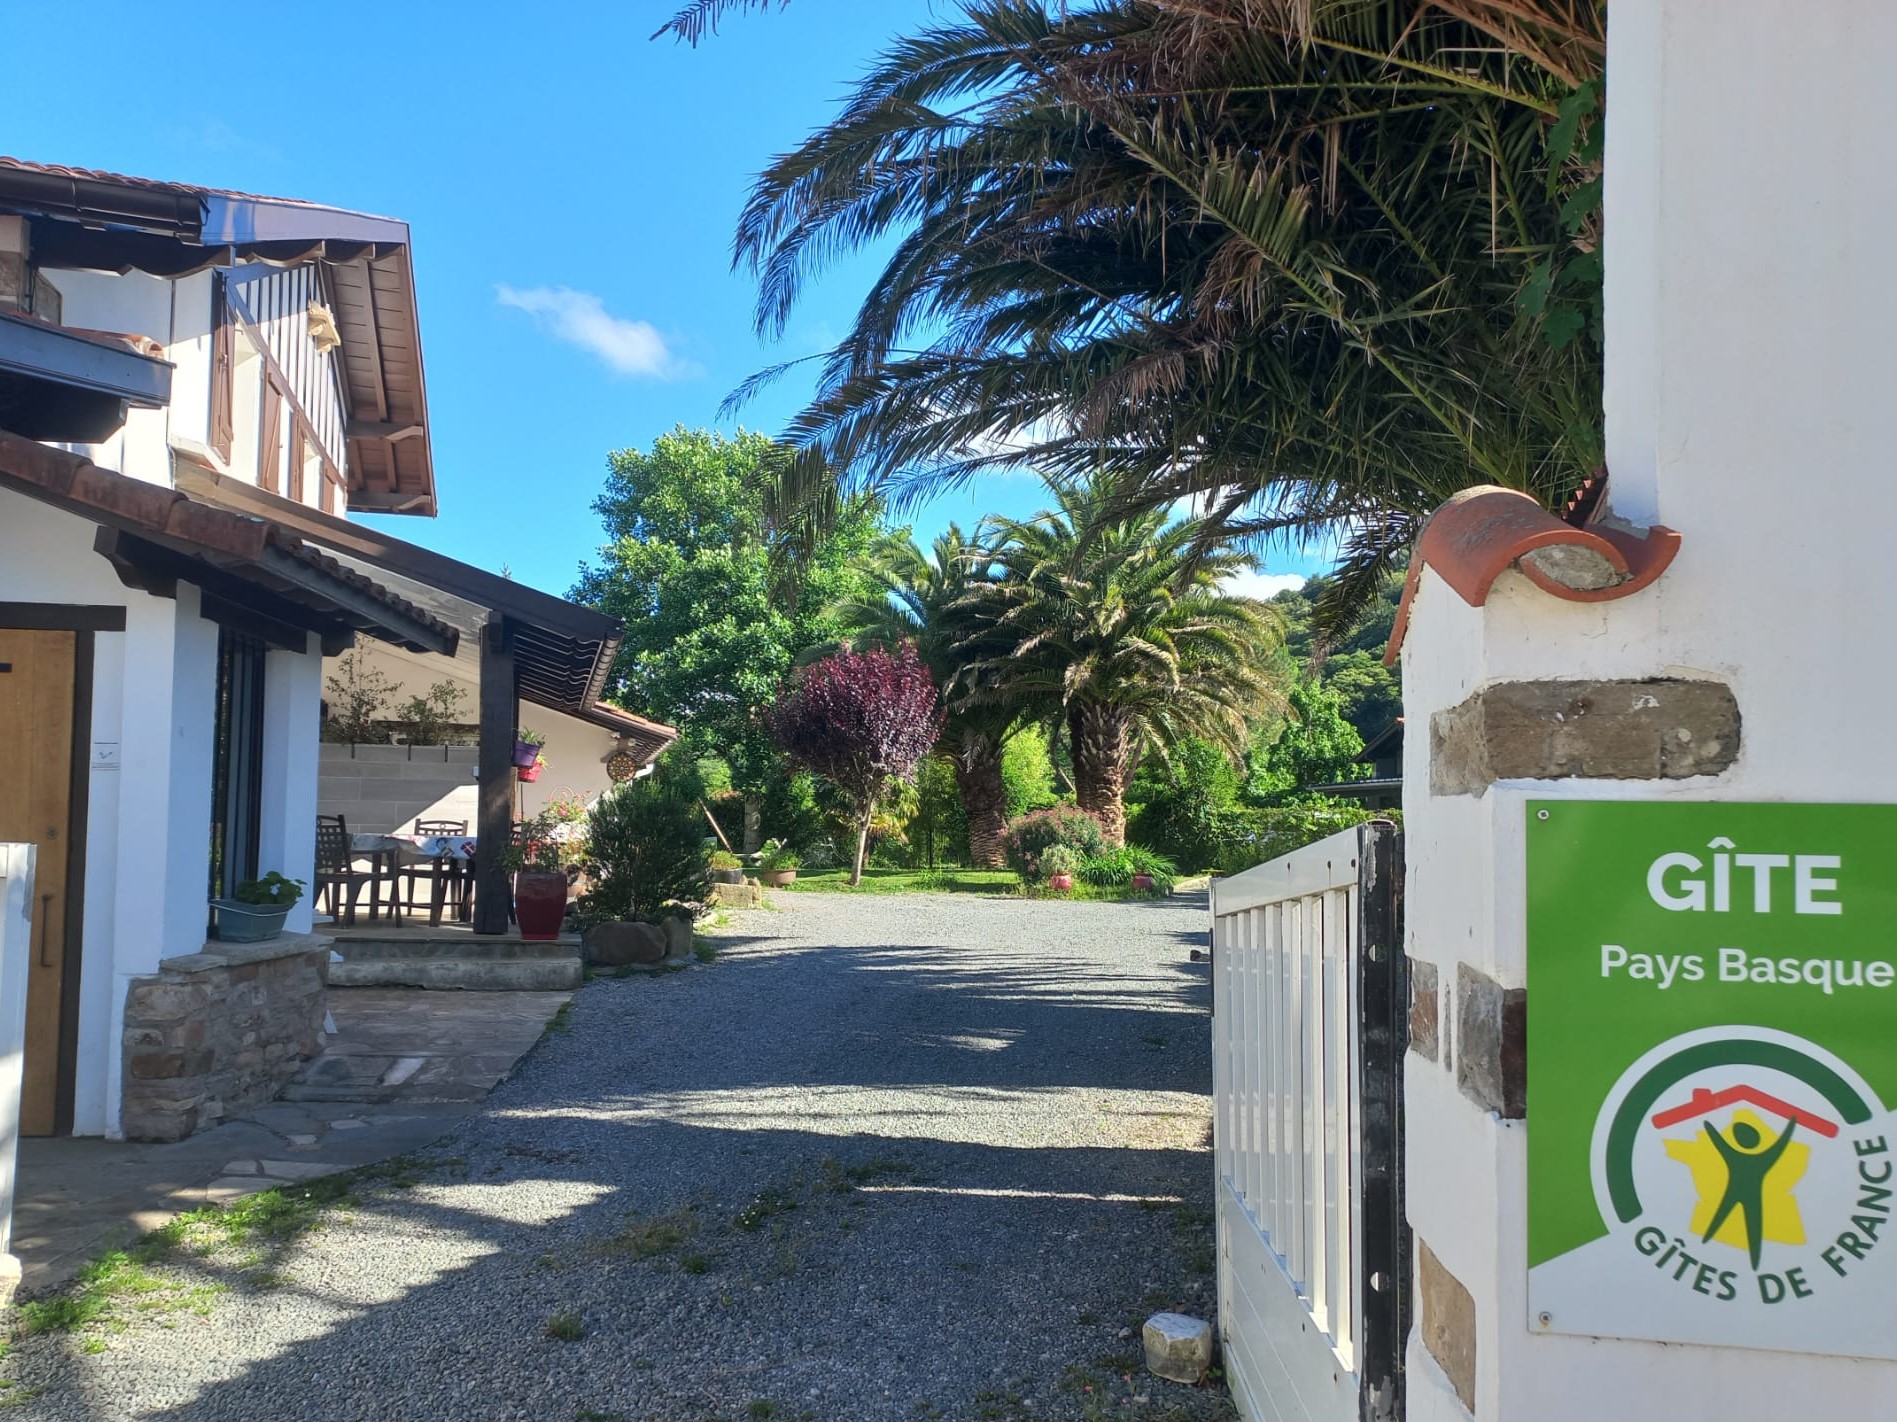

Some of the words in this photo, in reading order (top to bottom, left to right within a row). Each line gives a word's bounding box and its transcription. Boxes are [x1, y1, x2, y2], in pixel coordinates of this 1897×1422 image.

[1646, 836, 1843, 915] GÎTE
[1600, 944, 1705, 990] Pays
[1718, 947, 1896, 995] Basque
[1634, 1226, 1738, 1301] GÎTES
[1757, 1266, 1814, 1305] DE
[1820, 1135, 1893, 1278] FRANCE
